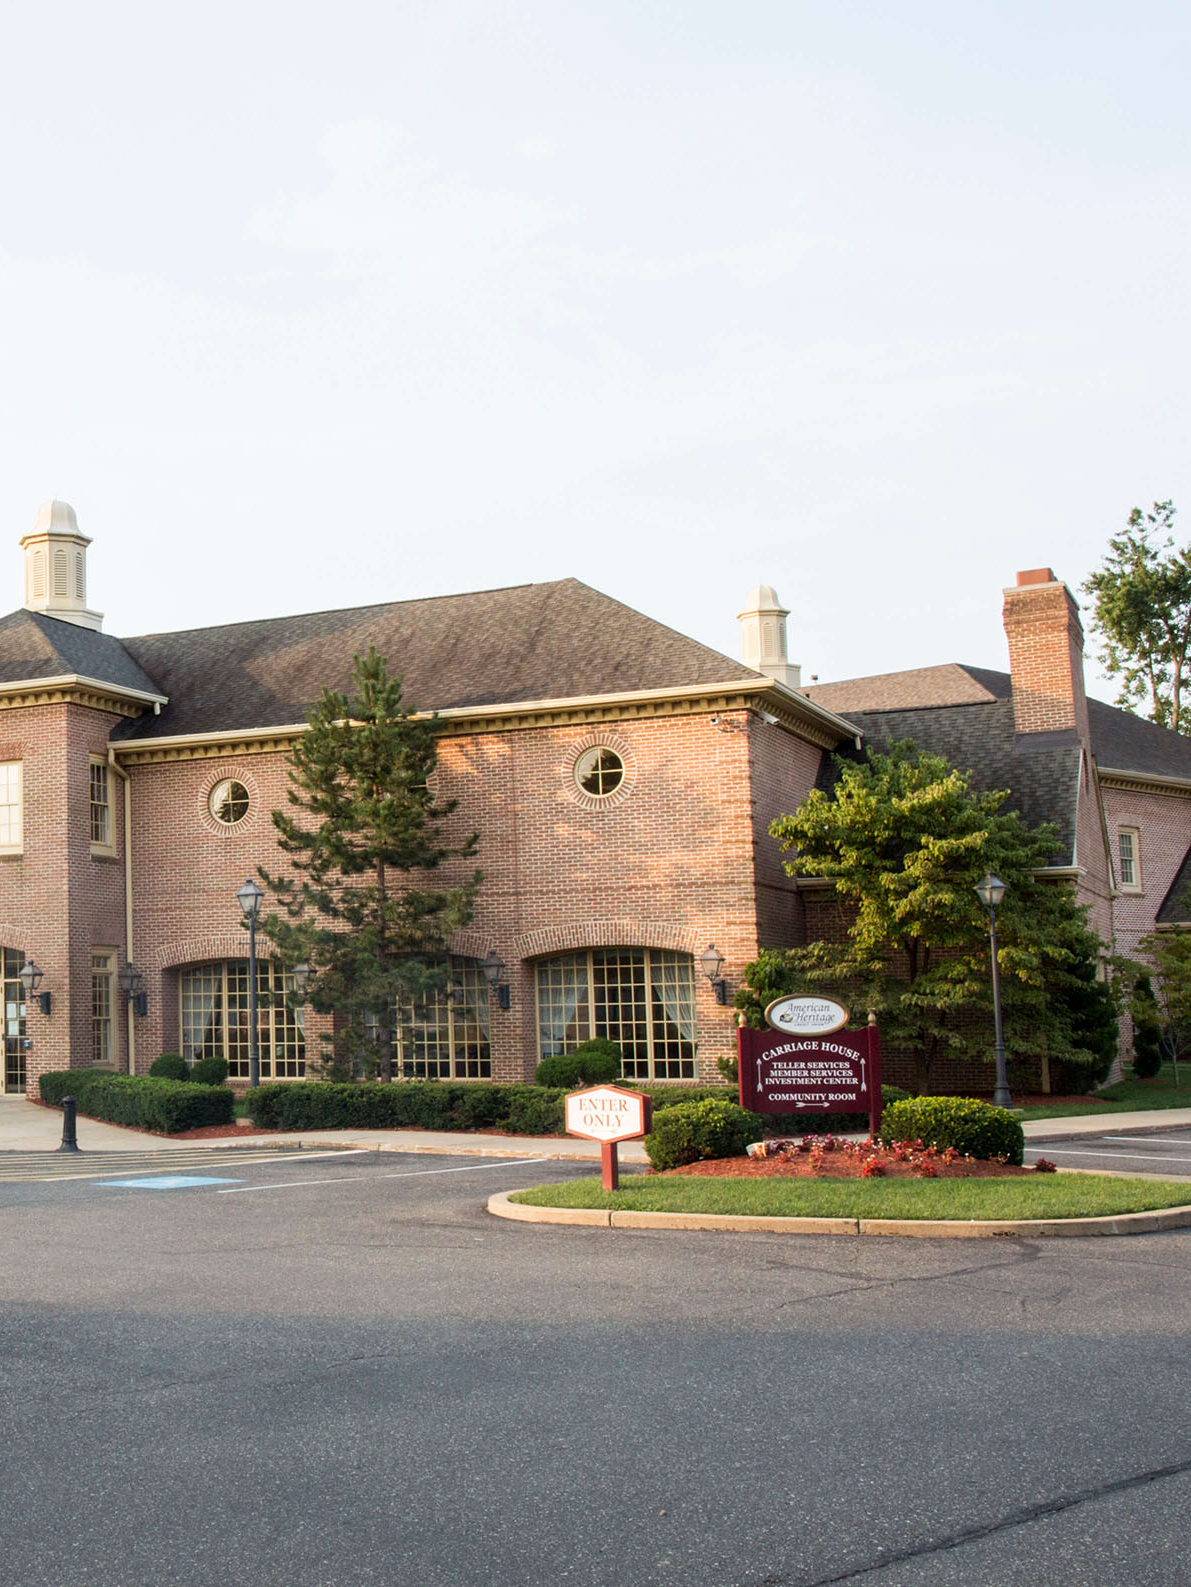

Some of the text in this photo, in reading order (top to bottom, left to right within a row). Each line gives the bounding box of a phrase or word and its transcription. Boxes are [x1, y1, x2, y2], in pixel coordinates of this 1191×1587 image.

[785, 1002, 830, 1014] American
[762, 1041, 860, 1061] CARRIAGE HOUSE
[807, 1061, 850, 1069] SERVICES
[810, 1069, 853, 1077] SERVICES
[765, 1077, 859, 1085] INVESTMENT CENTER
[768, 1093, 856, 1101] COMMUNITY ROOM
[579, 1098, 629, 1112] ENTER
[583, 1114, 625, 1127] ONLY
